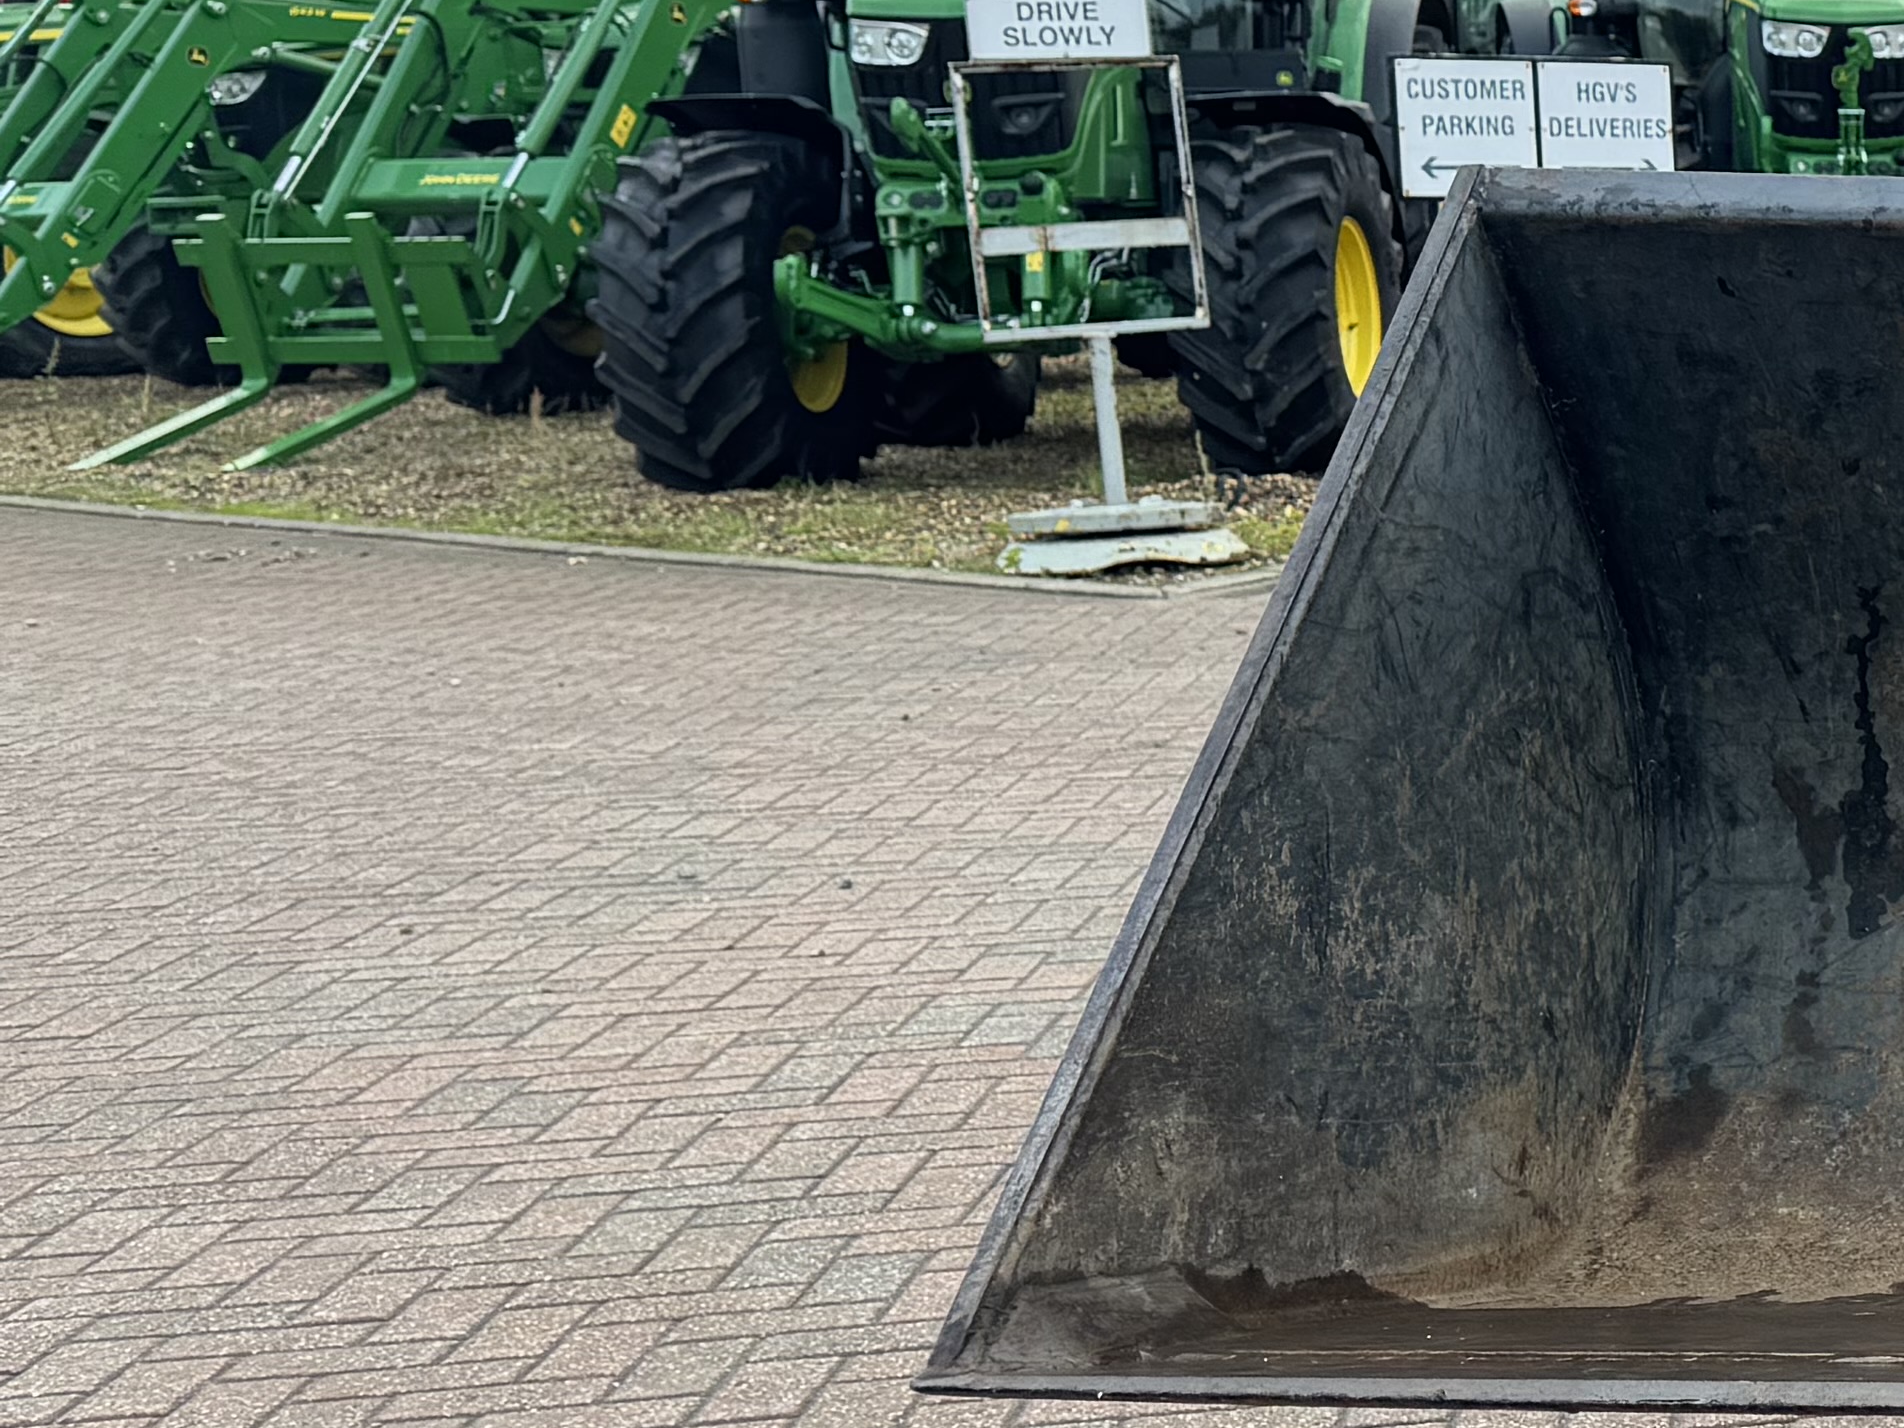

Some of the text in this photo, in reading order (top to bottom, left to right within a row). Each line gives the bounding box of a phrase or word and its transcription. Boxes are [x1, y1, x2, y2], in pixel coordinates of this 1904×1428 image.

[1016, 0, 1100, 22] DRIVE
[1003, 25, 1116, 47] SLOWLY
[1406, 77, 1526, 101] CUSTOMER
[1576, 81, 1638, 104] HGV'S
[1421, 114, 1515, 137] PARKING
[1549, 116, 1668, 139] DELIVERIES
